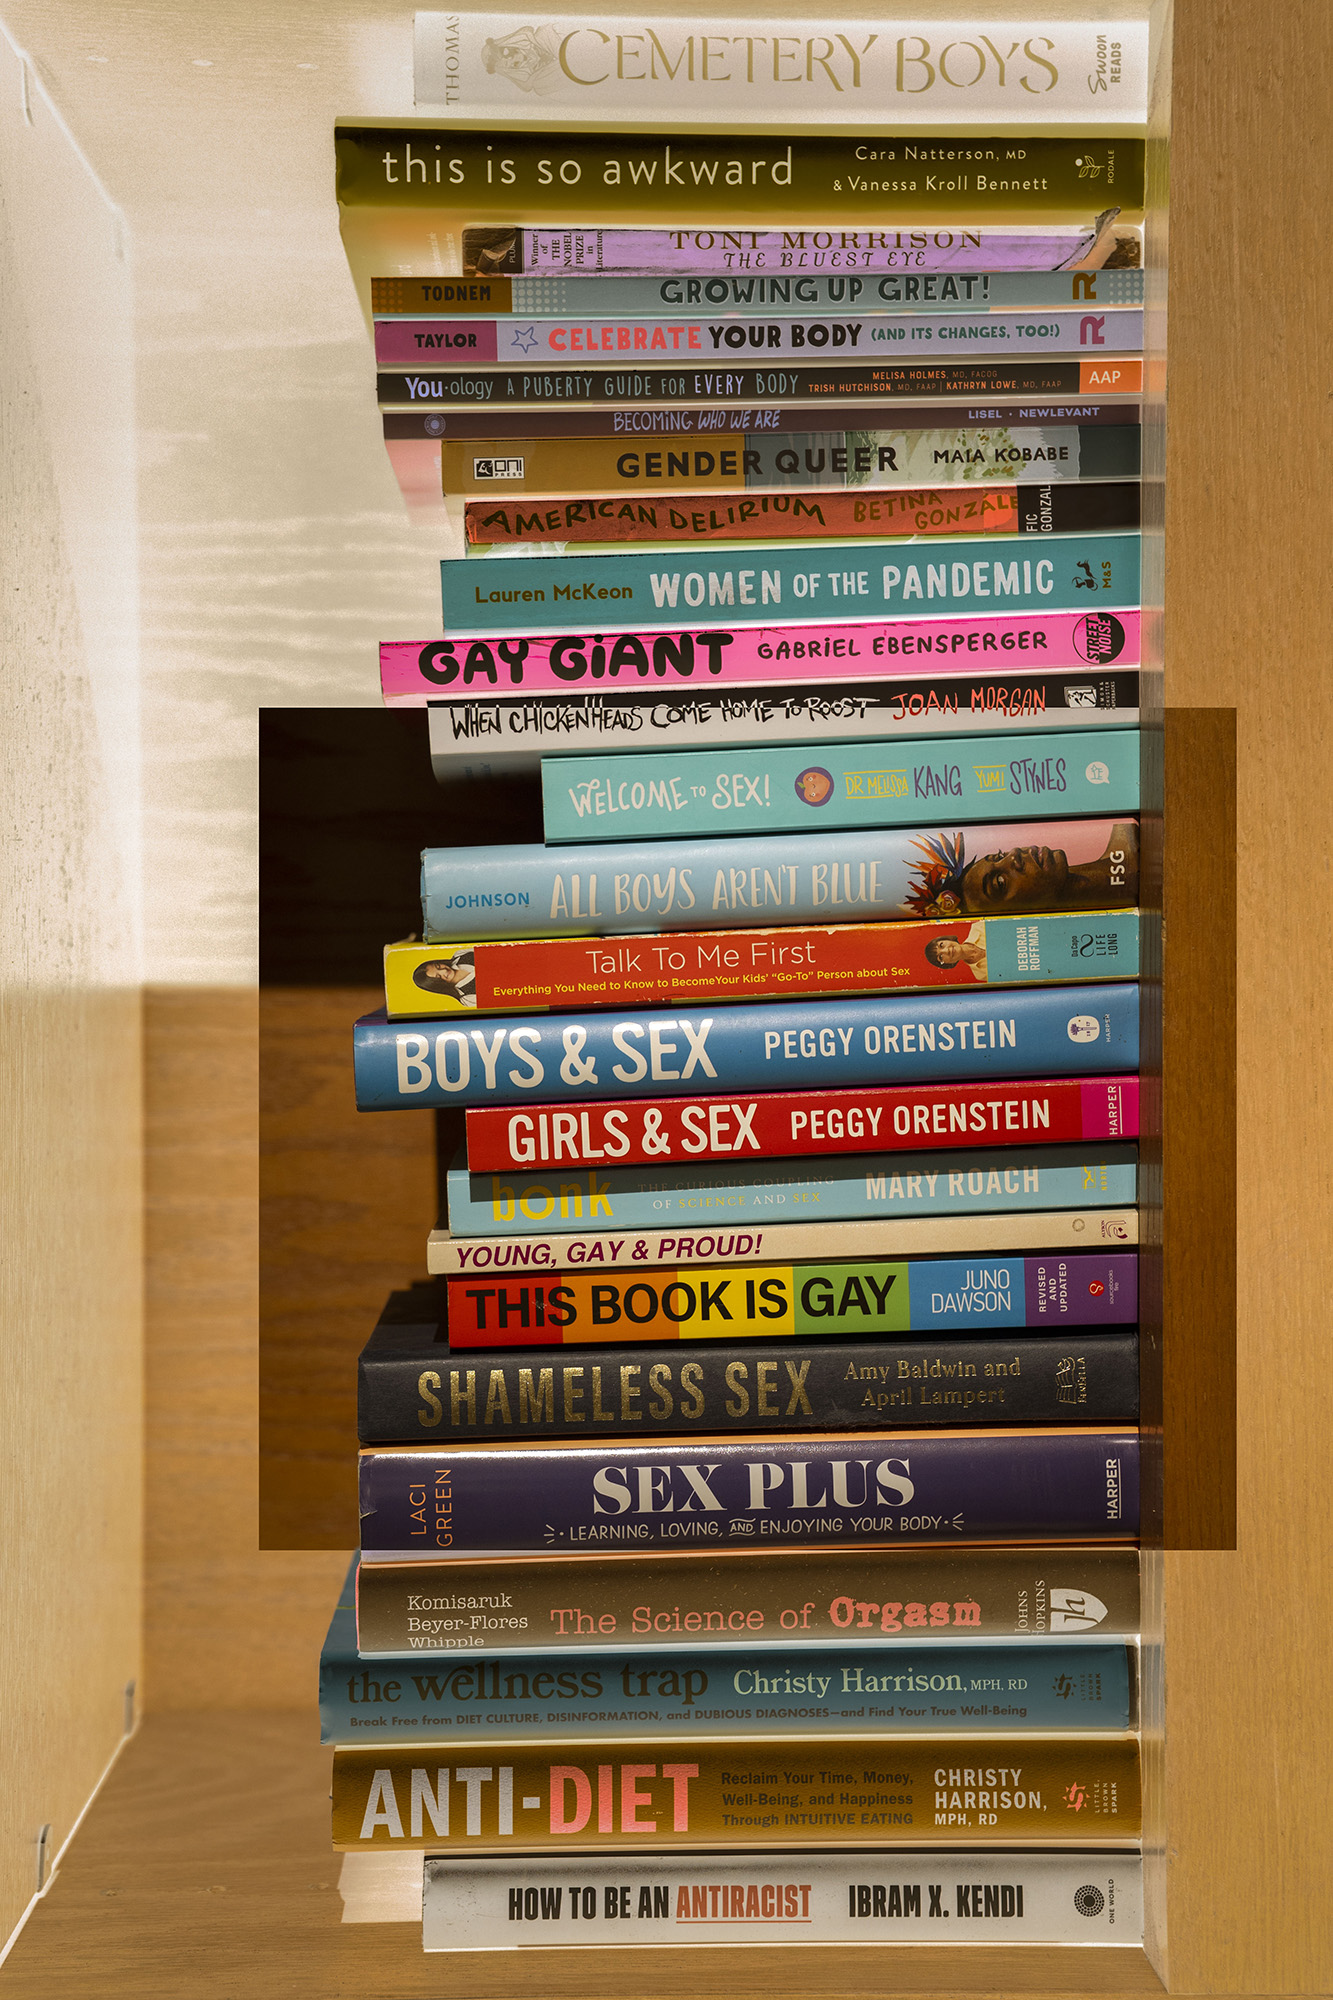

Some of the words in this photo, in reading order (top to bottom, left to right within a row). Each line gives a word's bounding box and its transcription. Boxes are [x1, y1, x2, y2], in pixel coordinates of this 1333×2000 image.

[446, 14, 460, 105] THOMAS
[559, 28, 878, 92] CEMETERY
[896, 35, 1059, 93] BOYS
[1111, 42, 1122, 83] READS
[382, 143, 465, 184] this
[487, 145, 516, 184] is
[537, 159, 581, 185] so
[603, 145, 792, 185] awkward
[855, 145, 896, 160] Cara
[904, 145, 999, 162] Natterson,
[1107, 149, 1115, 183] RODALE
[848, 176, 917, 191] Vanessa
[926, 175, 968, 191] Kroll
[976, 175, 1048, 190] Bennett
[531, 234, 539, 265] Winner
[552, 239, 560, 260] THE
[564, 232, 572, 266] NOBEL
[576, 235, 584, 264] PRIZE
[421, 285, 491, 301] TODNEM
[660, 278, 818, 304] GROWING
[828, 277, 863, 302] UP
[878, 276, 991, 302] GREAT!
[414, 334, 477, 348] TAYLOR
[548, 326, 701, 351] CELEBRATE
[709, 325, 781, 349] YOUR
[791, 323, 862, 348] BODY
[871, 327, 906, 341] (AND
[911, 327, 933, 340] ITS
[938, 326, 1010, 340] CHANGES,
[1016, 323, 1061, 338] TOO!)
[523, 377, 593, 397] PUBERTY
[604, 375, 652, 396] GUIDE
[661, 378, 686, 396] FOR
[695, 374, 744, 395] EVERY
[755, 373, 799, 394] BODY
[1089, 371, 1121, 384] AAP
[968, 410, 1002, 419] LISEL
[1019, 407, 1100, 418] NEWLEVANT
[617, 450, 763, 478] GENDER
[775, 446, 899, 475] QUEER
[934, 449, 985, 464] MAIA
[995, 446, 1069, 463] KOBABE
[482, 500, 657, 536] AMERICAN
[670, 497, 826, 533] DELIRIUM
[475, 586, 545, 604] Lauren
[553, 582, 633, 601] McKeon
[650, 570, 781, 608] WOMEN
[793, 573, 821, 598] OF
[828, 571, 869, 596] THE
[882, 559, 1054, 600] PANDEMIC
[872, 631, 1048, 655] EBENSPERGER
[418, 639, 530, 685] GAY
[891, 690, 958, 720] JOAN
[971, 686, 1046, 717] MORGAN
[914, 764, 963, 799] KANG
[1009, 758, 1067, 795] STYNES
[568, 777, 688, 818] WELCOME
[712, 773, 771, 810] SEX!
[1110, 850, 1125, 886] FSG
[445, 892, 530, 909] JOHNSON
[550, 873, 602, 919] ALL
[614, 866, 696, 916] BOYS
[712, 864, 799, 910] AREN'T
[812, 860, 884, 906] BLUE
[585, 947, 642, 974] Talk
[652, 947, 686, 971] To
[698, 944, 740, 969] Me
[751, 941, 816, 966] First
[1016, 927, 1028, 971] DEBORAH
[1028, 926, 1040, 970] ROFFMAN
[1096, 933, 1106, 955] LIFE
[1107, 933, 1118, 955] LONG
[493, 984, 551, 997] Everything
[554, 983, 575, 993] You
[578, 982, 606, 992] Need
[624, 980, 654, 989] Know
[817, 970, 853, 980] Person
[856, 967, 888, 978] about
[891, 967, 910, 976] Sex
[397, 1027, 544, 1094] BOYS
[560, 1025, 598, 1085] &
[612, 1018, 718, 1083] SEX
[765, 1027, 853, 1060] PEGGY
[864, 1019, 1016, 1055] ORENSTEIN
[791, 1107, 882, 1140] PEGGY
[894, 1099, 1049, 1135] ORENSTEIN
[1108, 1085, 1117, 1135] HARPER
[508, 1109, 630, 1162] GIRLS
[642, 1108, 671, 1155] &
[681, 1103, 761, 1153] SEX
[492, 1171, 613, 1221] bonk
[866, 1169, 939, 1200] MARY
[949, 1165, 1039, 1196] ROACH
[456, 1244, 557, 1268] YOUNG,
[567, 1241, 625, 1264] GAY
[631, 1240, 649, 1260] &
[658, 1234, 763, 1259] PROUD!
[961, 1269, 1010, 1291] JUNO
[1038, 1267, 1046, 1312] REVISED
[1049, 1278, 1057, 1301] AND
[1059, 1263, 1068, 1312] UPDATED
[466, 1286, 577, 1329] THIS
[592, 1281, 733, 1325] BOOK
[746, 1279, 788, 1319] IS
[801, 1275, 896, 1317] GAY
[932, 1291, 1011, 1314] DAWSON
[844, 1361, 890, 1384] Amy
[897, 1358, 977, 1379] Baldwin
[983, 1357, 1021, 1376] and
[417, 1363, 705, 1427] SHAMELESS
[725, 1360, 813, 1418] SEX
[593, 1463, 727, 1515] SEX
[744, 1458, 915, 1510] PLUS
[1106, 1458, 1118, 1519] HARPER
[410, 1485, 427, 1535] LACI
[435, 1470, 453, 1546] GREEN
[407, 1593, 513, 1611] Komisaruk
[550, 1608, 616, 1634] The
[632, 1606, 764, 1633] Science
[780, 1602, 815, 1629] of
[828, 1596, 982, 1632] Orgasm
[407, 1615, 528, 1633] Beyer-Flores
[347, 1671, 401, 1703] the
[411, 1660, 603, 1701] wellness
[620, 1663, 708, 1705] trap
[733, 1669, 831, 1698] Christy
[840, 1667, 968, 1693] Harrison,
[722, 1772, 778, 1785] Reclaim
[783, 1772, 815, 1784] Your
[819, 1772, 857, 1786] Time,
[864, 1772, 913, 1786] Money,
[934, 1768, 1022, 1787] CHRISTY
[360, 1764, 699, 1838] ANTI-DIET
[723, 1793, 803, 1807] Well-Being,
[809, 1793, 834, 1806] and
[839, 1793, 913, 1807] Happiness
[935, 1791, 1047, 1811] HARRISON,
[722, 1814, 778, 1827] Through
[785, 1814, 855, 1825] INTUITIVE
[861, 1813, 913, 1825] EATING
[508, 1887, 562, 1921] HOW
[569, 1887, 596, 1920] TO
[604, 1886, 631, 1919] BE
[638, 1886, 669, 1919] AN
[676, 1884, 812, 1919] ANTIRACIST
[849, 1885, 921, 1918] IBRAM
[928, 1885, 949, 1918] X.
[957, 1885, 1024, 1918] KENDI
